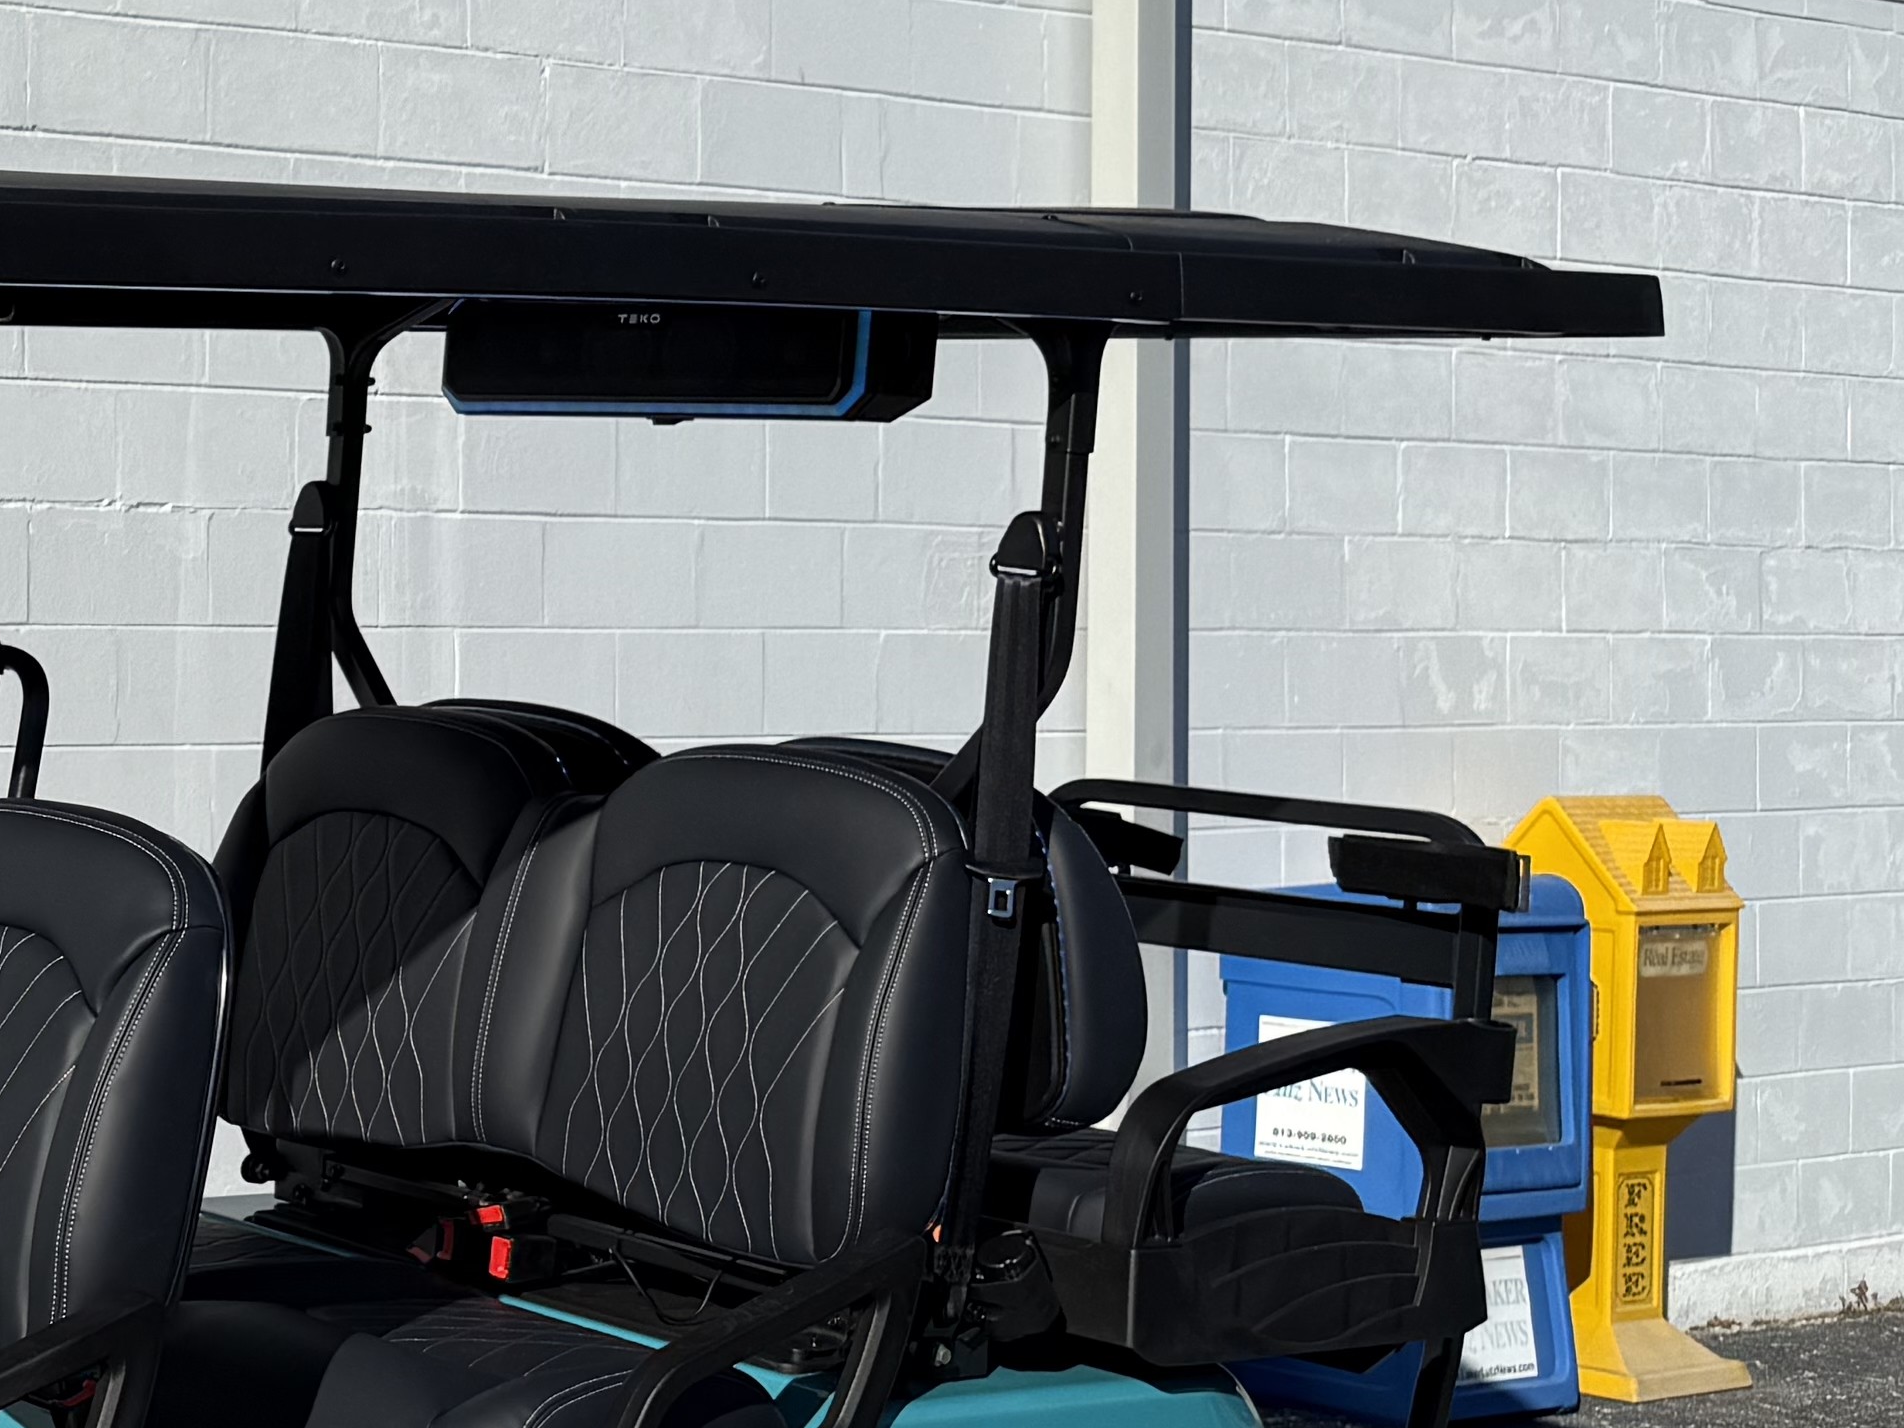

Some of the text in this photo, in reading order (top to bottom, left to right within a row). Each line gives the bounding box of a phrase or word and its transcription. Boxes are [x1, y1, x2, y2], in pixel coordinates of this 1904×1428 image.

[617, 313, 661, 324] TEKO
[1308, 1079, 1360, 1108] NEWS
[1623, 1182, 1648, 1298] FREE
[1487, 1277, 1528, 1307] KER
[1481, 1319, 1530, 1351] NEWS
